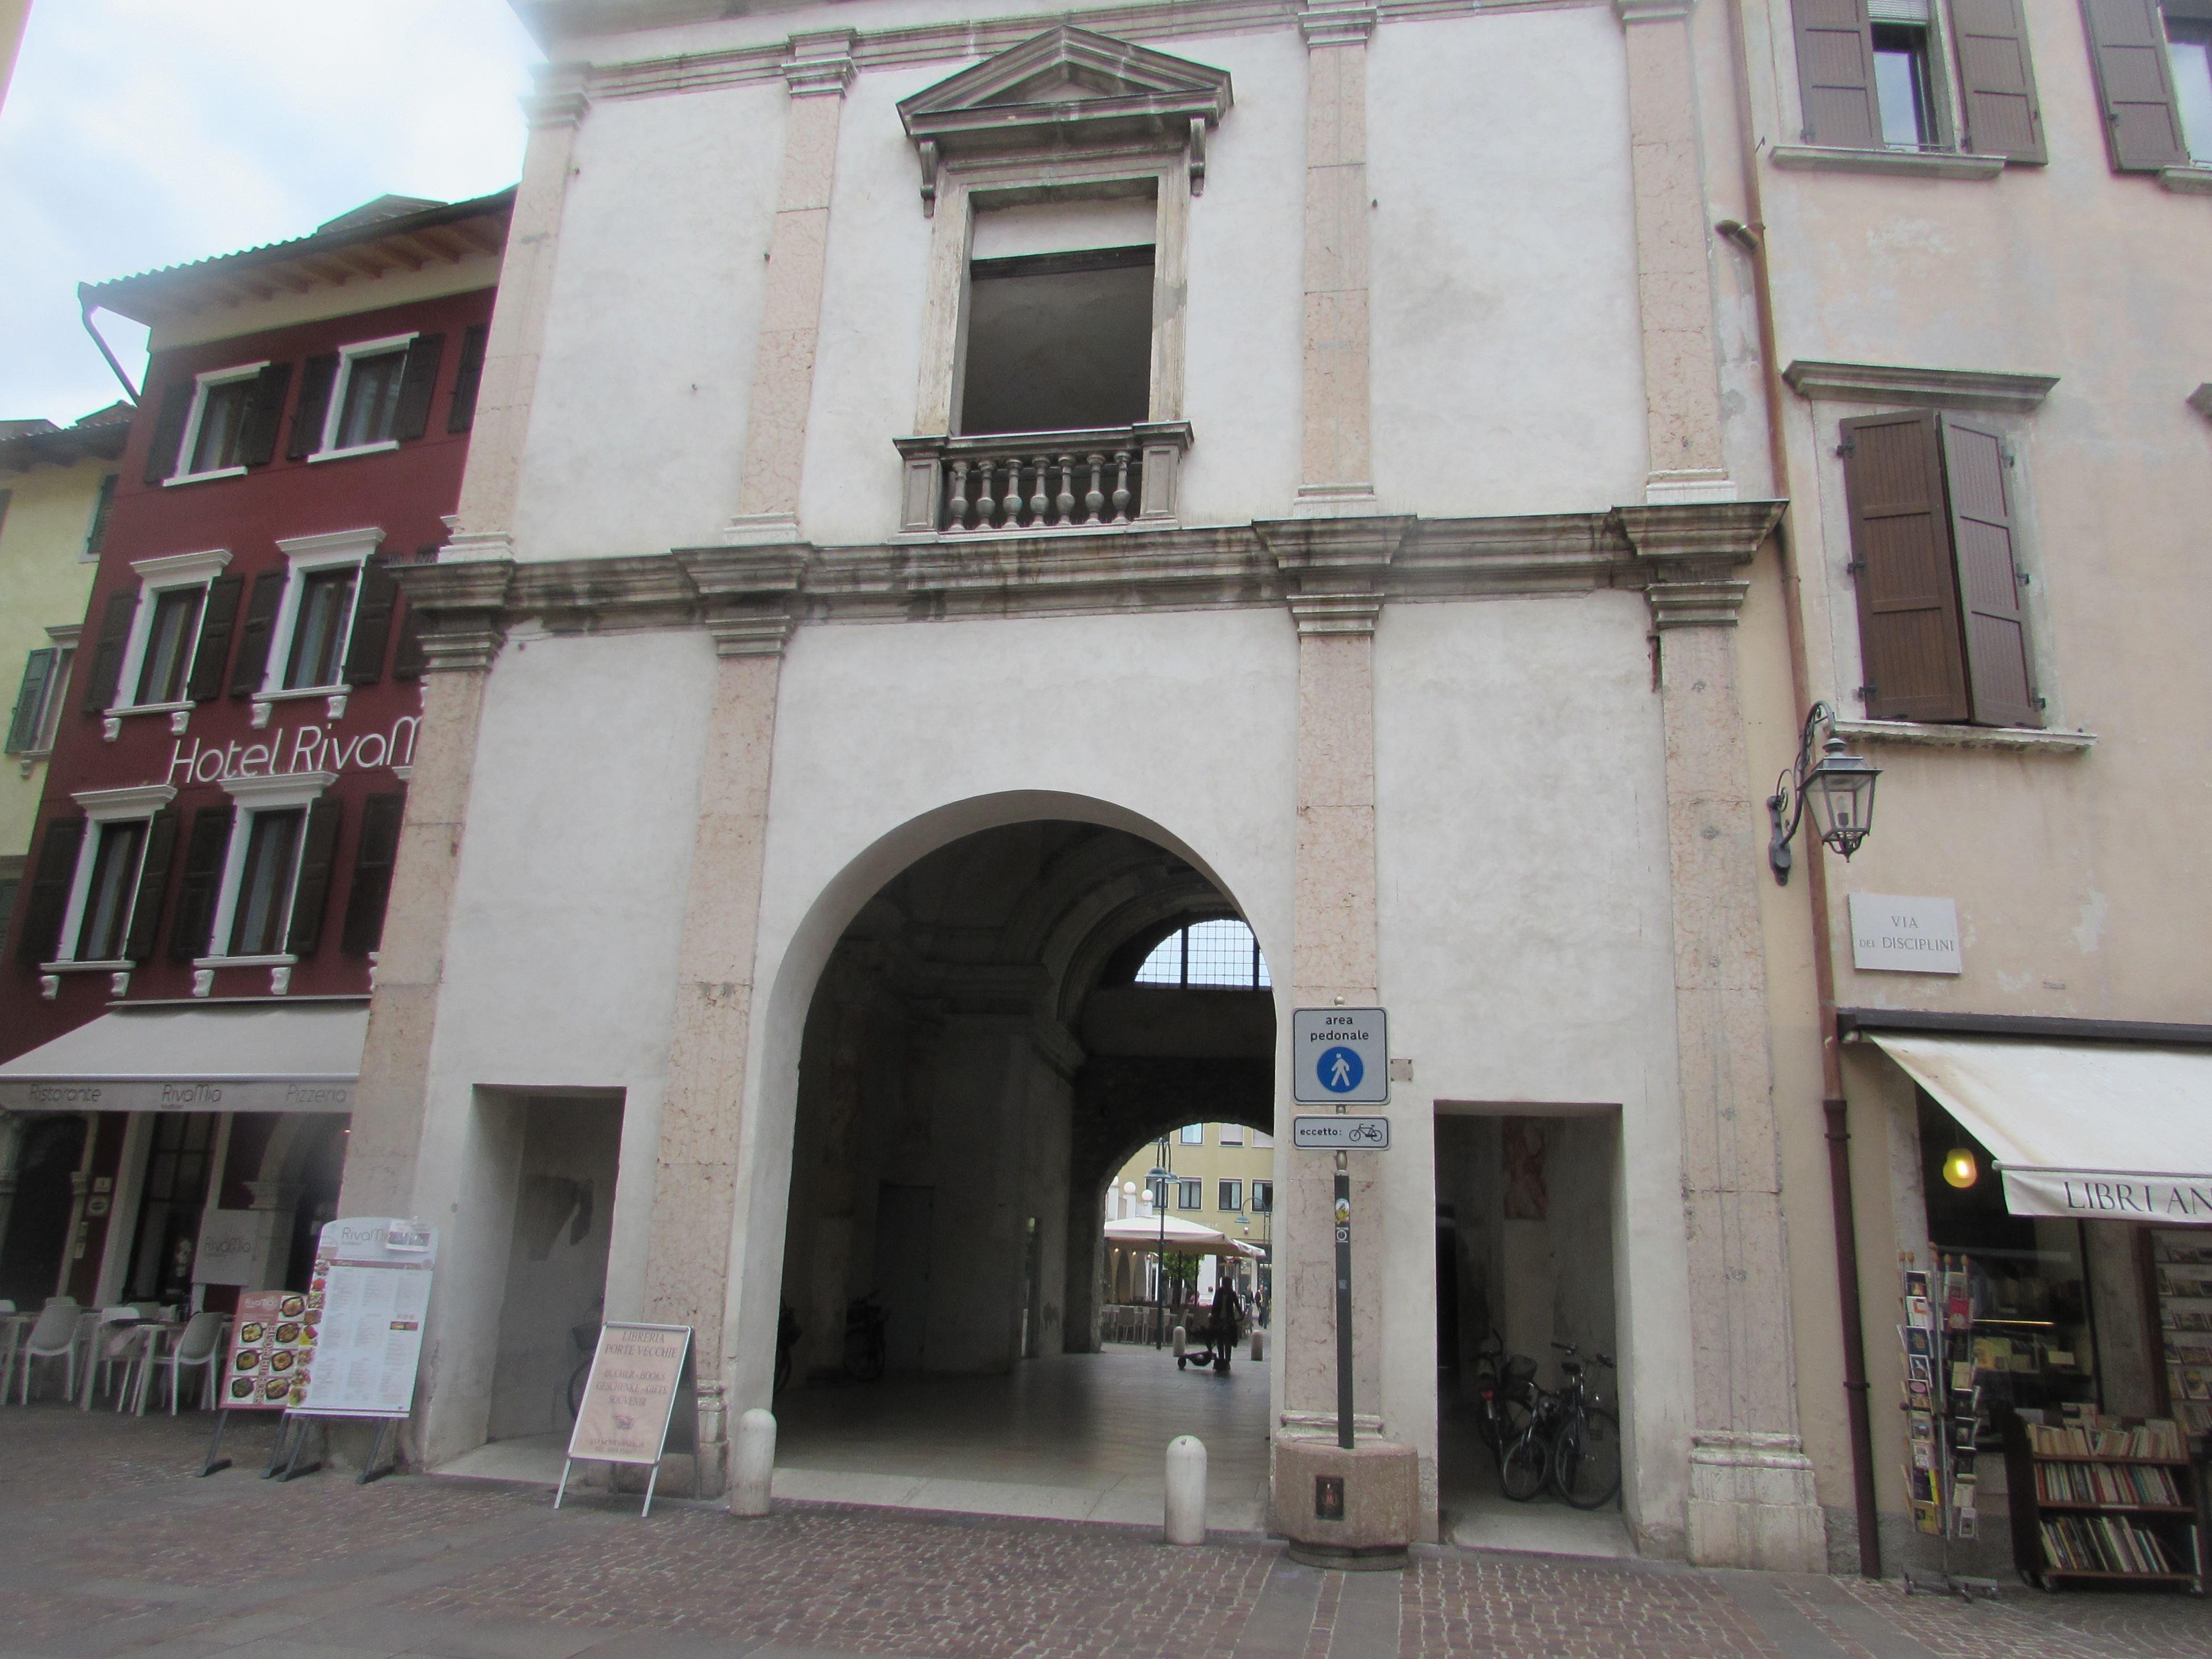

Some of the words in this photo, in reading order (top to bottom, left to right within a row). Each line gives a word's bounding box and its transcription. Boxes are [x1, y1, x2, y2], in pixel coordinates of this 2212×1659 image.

[167, 728, 283, 784] Hotel
[1891, 916, 1918, 928] VIA
[1859, 940, 1875, 948] DEI
[1882, 937, 1954, 952] DISCIPLINI
[1326, 1017, 1354, 1025] area
[1311, 1030, 1369, 1042] pedonale
[286, 1084, 347, 1103] Pizzeria
[1300, 1128, 1342, 1136] eccetto:
[2063, 1181, 2153, 1213] LIBRI
[623, 1331, 664, 1343] LIBRERIA
[605, 1344, 634, 1355] PORTE
[638, 1345, 678, 1358] VECCHIE
